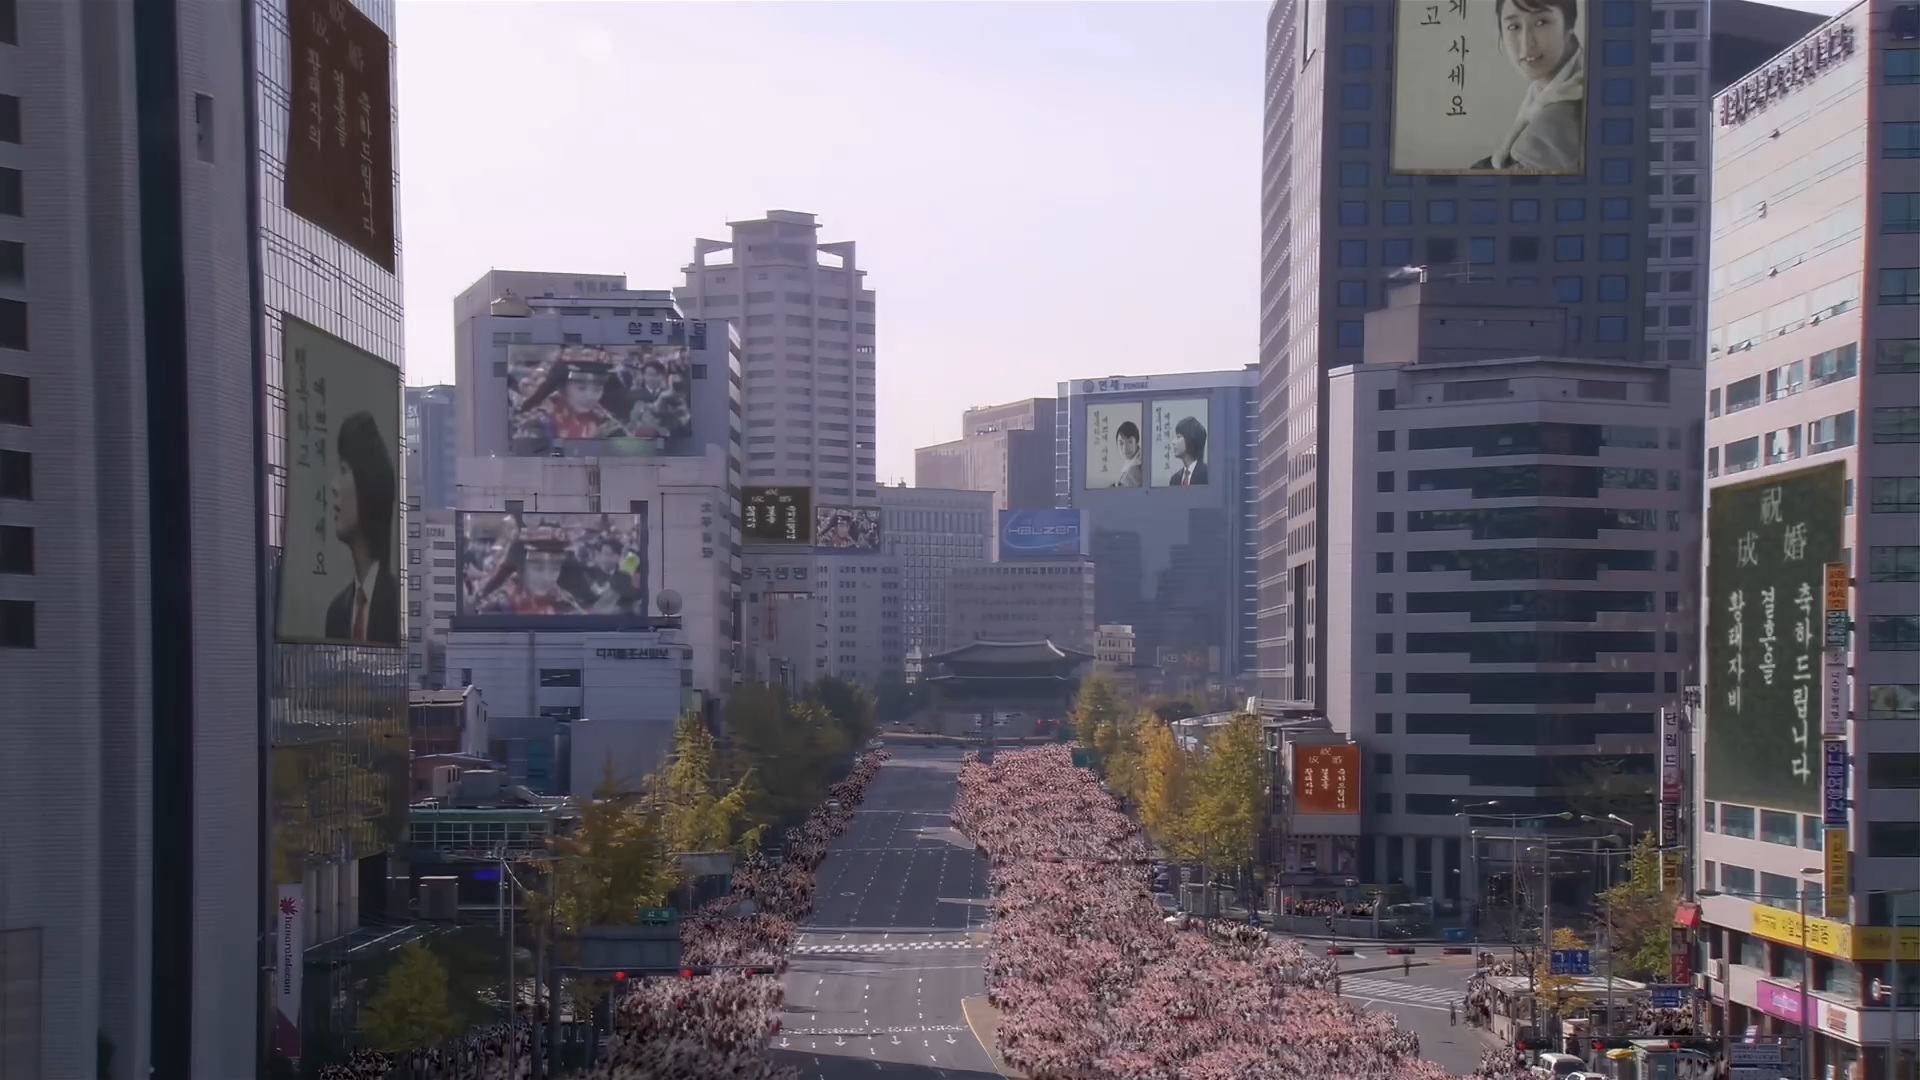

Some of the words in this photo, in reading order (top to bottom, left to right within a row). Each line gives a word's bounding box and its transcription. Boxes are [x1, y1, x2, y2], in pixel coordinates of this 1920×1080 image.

[1420, 5, 1441, 26] 고
[1445, 35, 1470, 117] 사세요
[1737, 530, 1758, 568] 成
[1783, 522, 1808, 563] 婚
[1759, 486, 1783, 523] 祝
[1727, 589, 1746, 714] 황태자비
[1758, 586, 1777, 686] 결혼을
[1792, 582, 1814, 786] 축하드립니다
